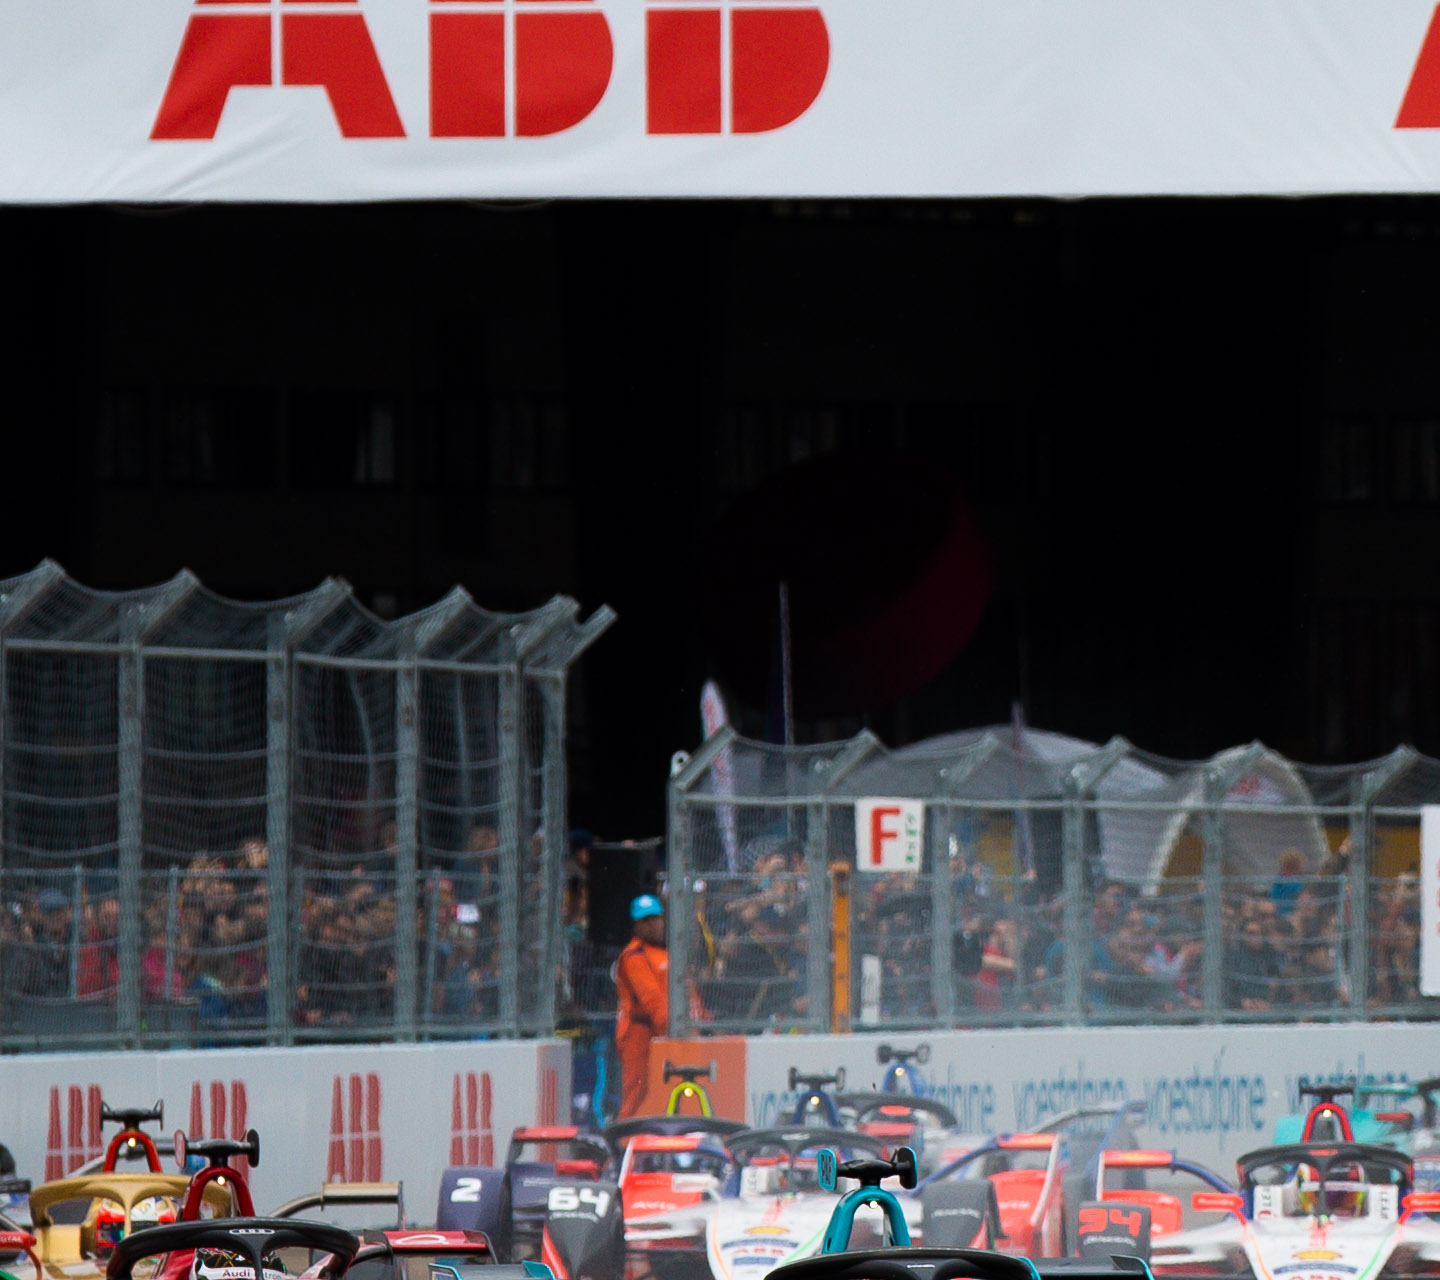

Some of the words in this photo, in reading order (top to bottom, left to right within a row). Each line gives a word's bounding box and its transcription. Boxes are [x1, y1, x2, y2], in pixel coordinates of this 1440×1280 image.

[870, 806, 901, 867] F
[328, 1072, 383, 1183] ABB
[451, 1071, 494, 1166] ABB
[547, 1186, 610, 1218] 64
[1078, 1207, 1142, 1238] 94
[222, 1268, 250, 1278] Audi
